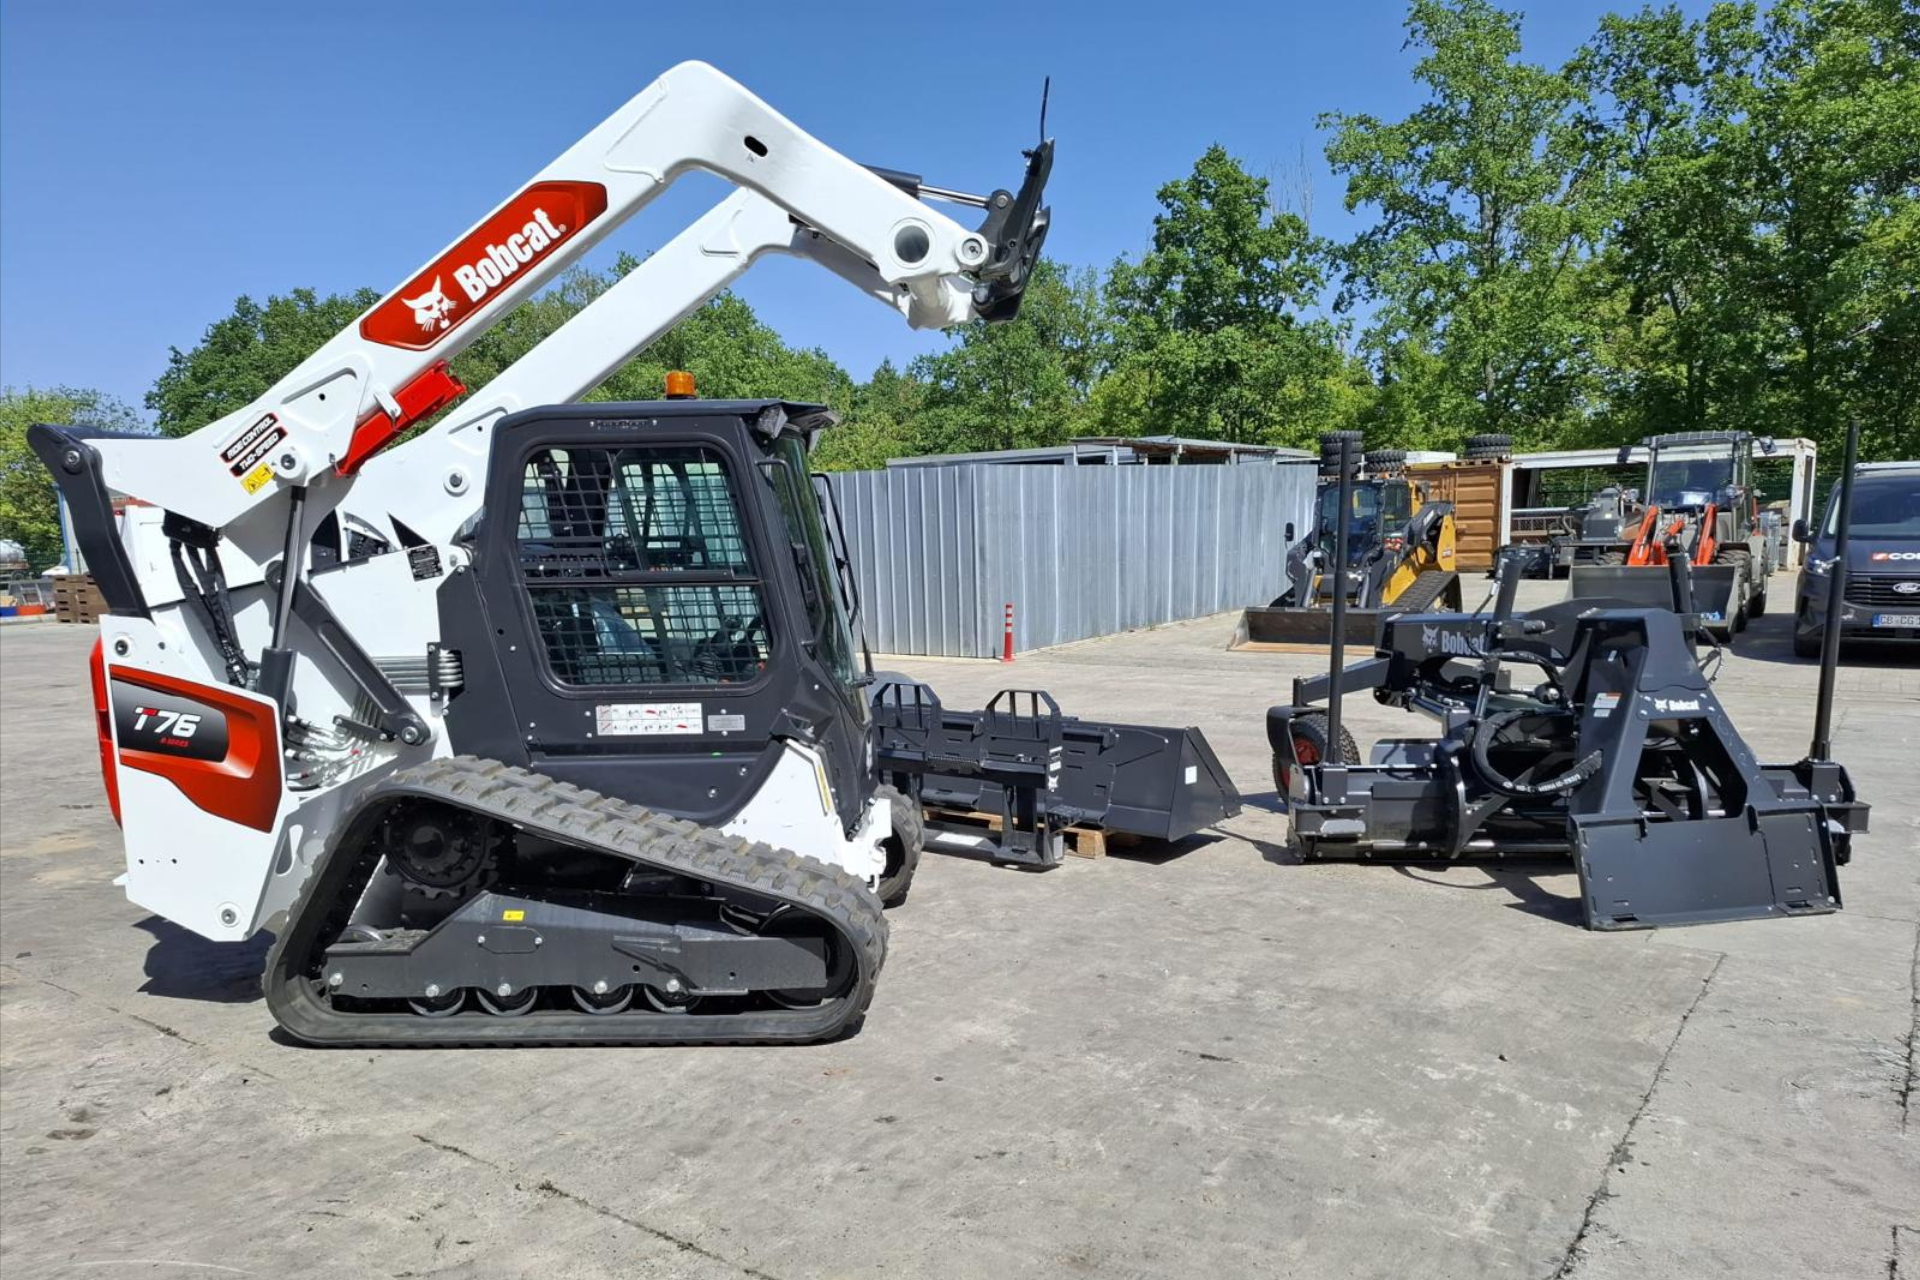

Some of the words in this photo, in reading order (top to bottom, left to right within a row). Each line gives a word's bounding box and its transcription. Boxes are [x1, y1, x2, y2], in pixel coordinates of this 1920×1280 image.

[226, 441, 245, 460] RIDE
[242, 416, 275, 446] CONTROL
[239, 431, 280, 470] TWO-SPEED
[134, 707, 201, 738] T76
[1668, 699, 1699, 711] Bobcat
